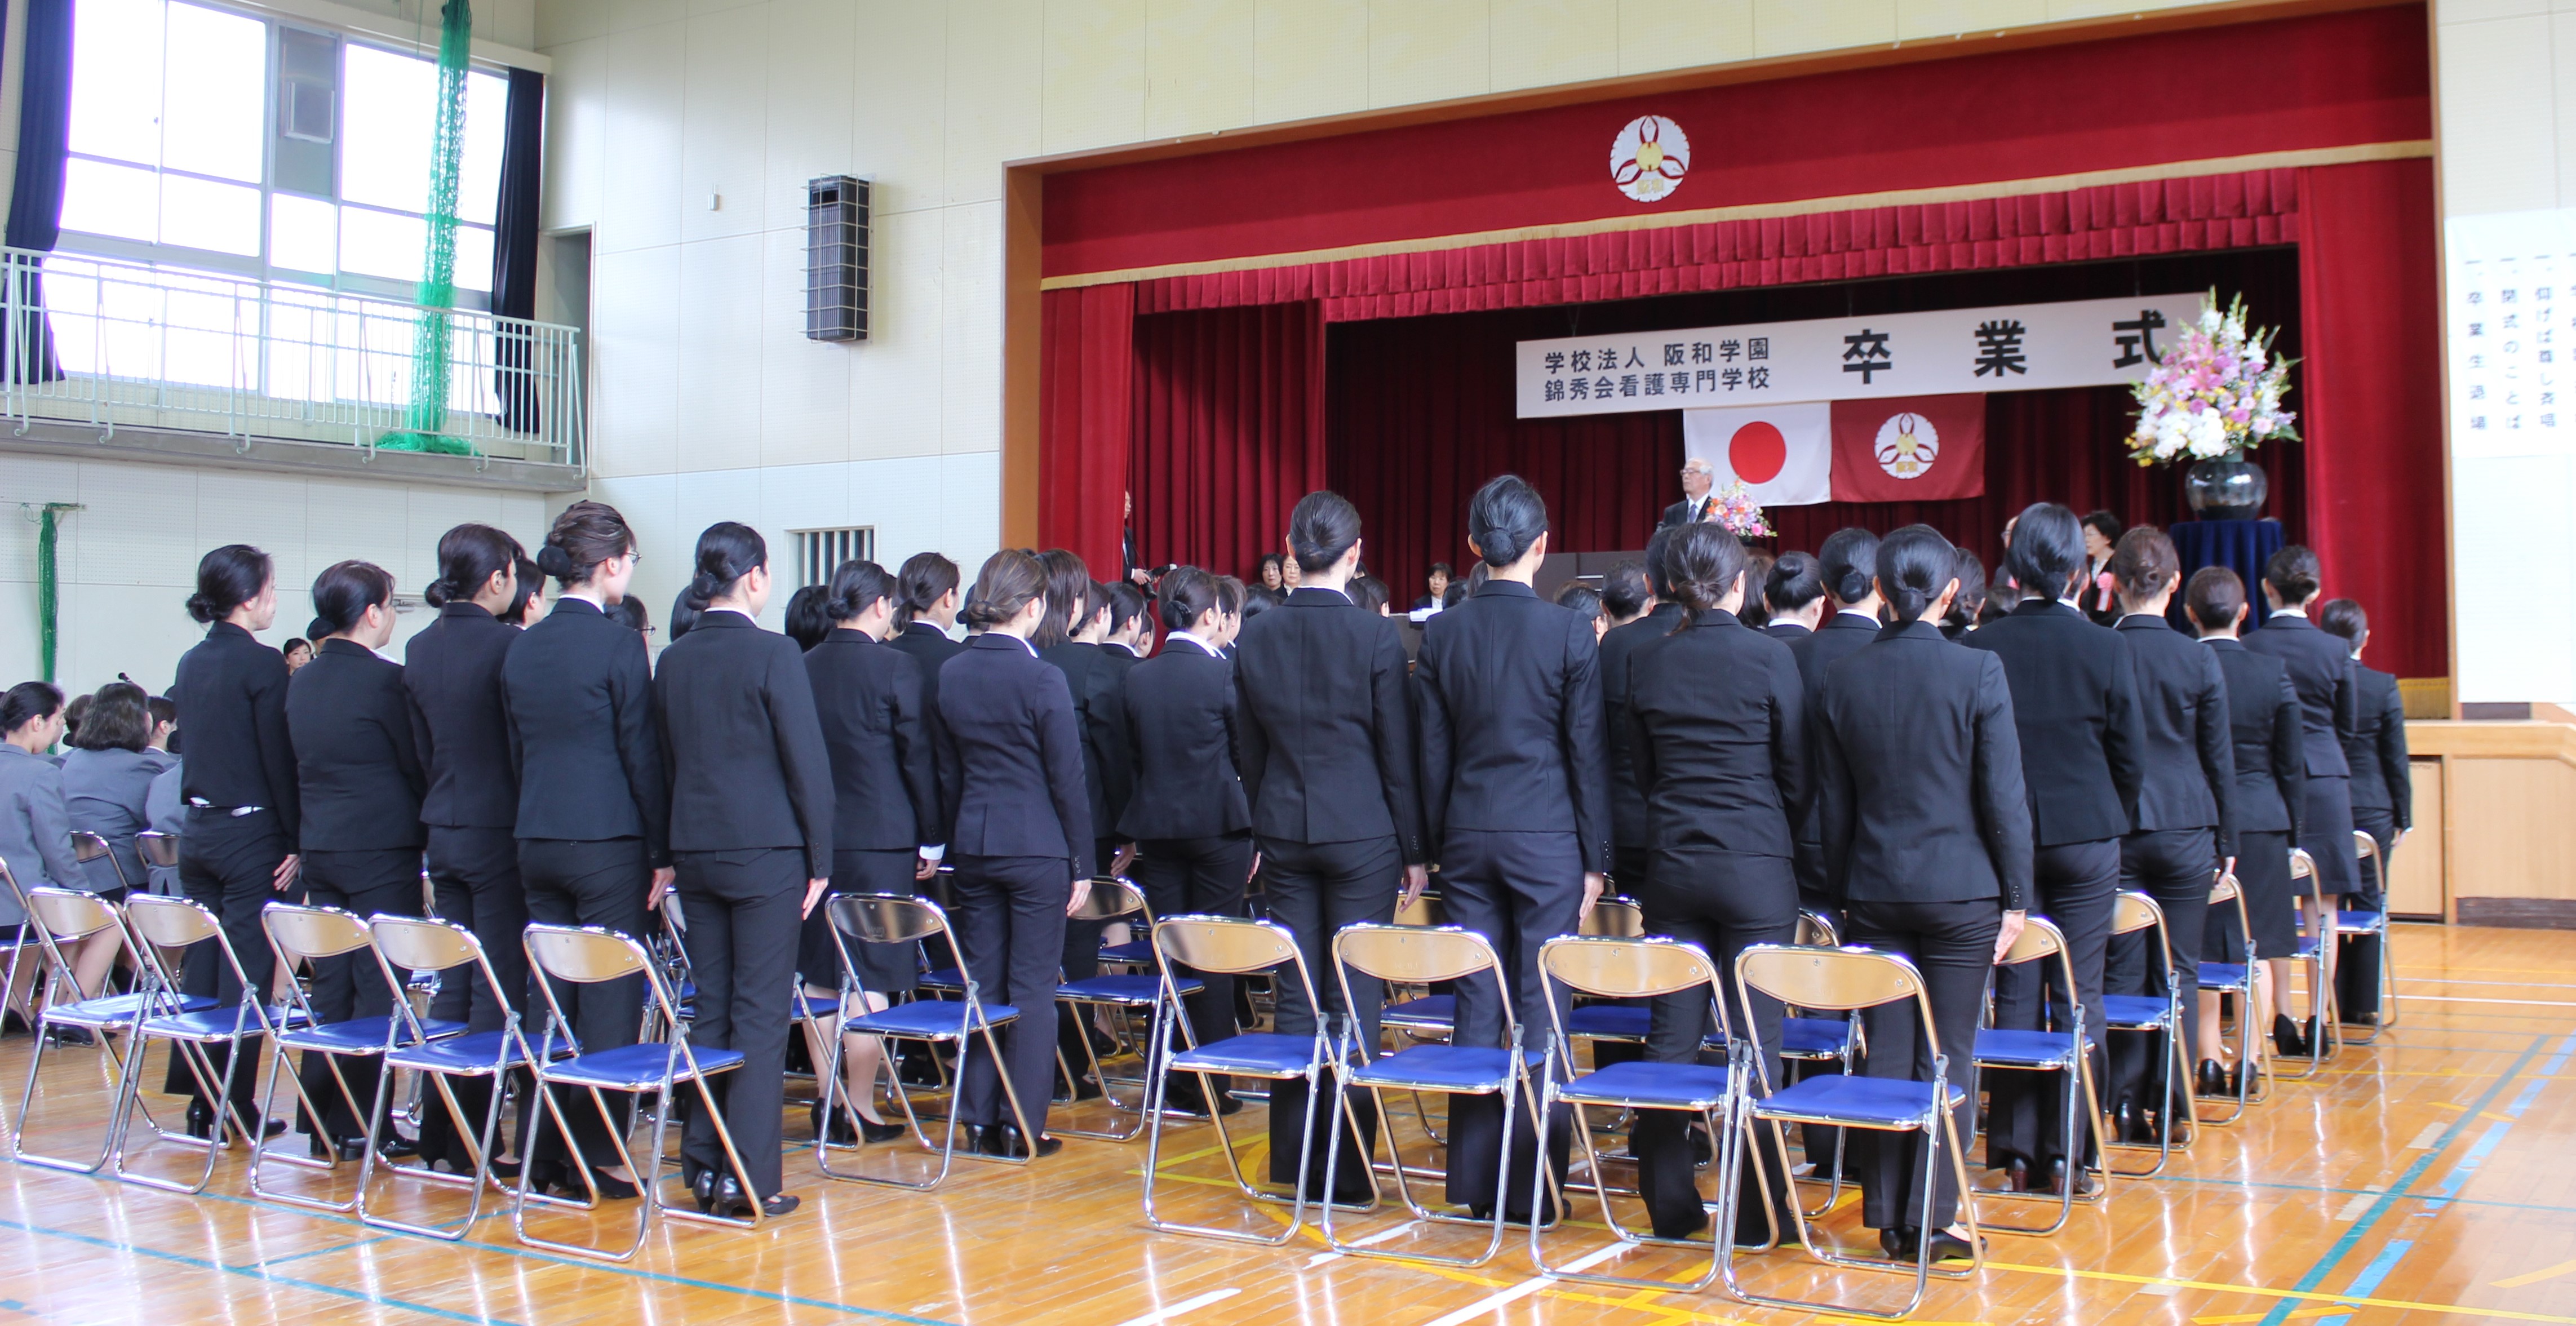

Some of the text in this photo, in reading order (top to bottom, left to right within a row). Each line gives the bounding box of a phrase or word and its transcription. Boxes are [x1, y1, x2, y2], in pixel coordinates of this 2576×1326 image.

[1545, 338, 1769, 374] 学校法人 阪和学園
[1544, 366, 1770, 402] 錦秀会看護専門学校
